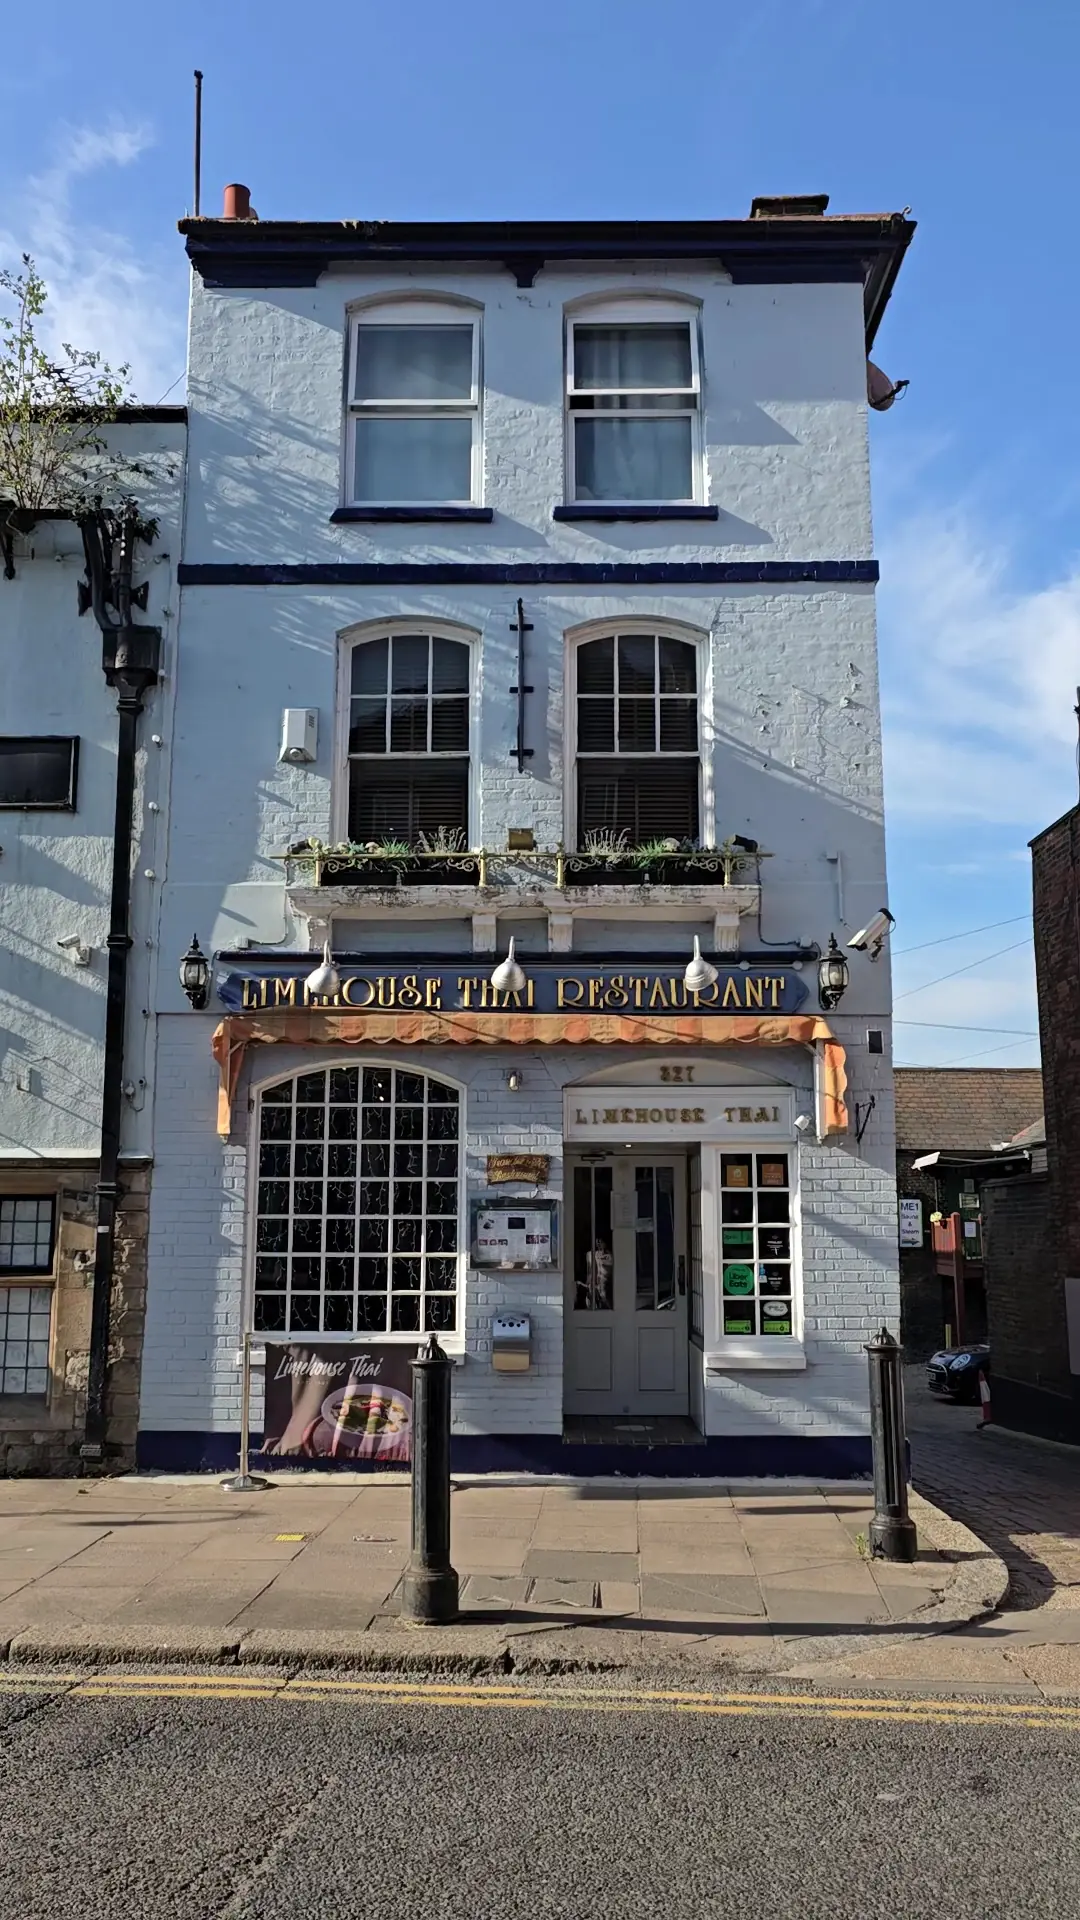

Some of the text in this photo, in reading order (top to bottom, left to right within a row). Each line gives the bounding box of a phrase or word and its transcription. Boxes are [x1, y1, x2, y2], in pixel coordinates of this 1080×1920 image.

[659, 1065, 695, 1082] 327
[575, 1106, 780, 1124] LIMEHOUSE THAI
[901, 1203, 919, 1211] ME1
[273, 1353, 384, 1380] Limehouse Thai
